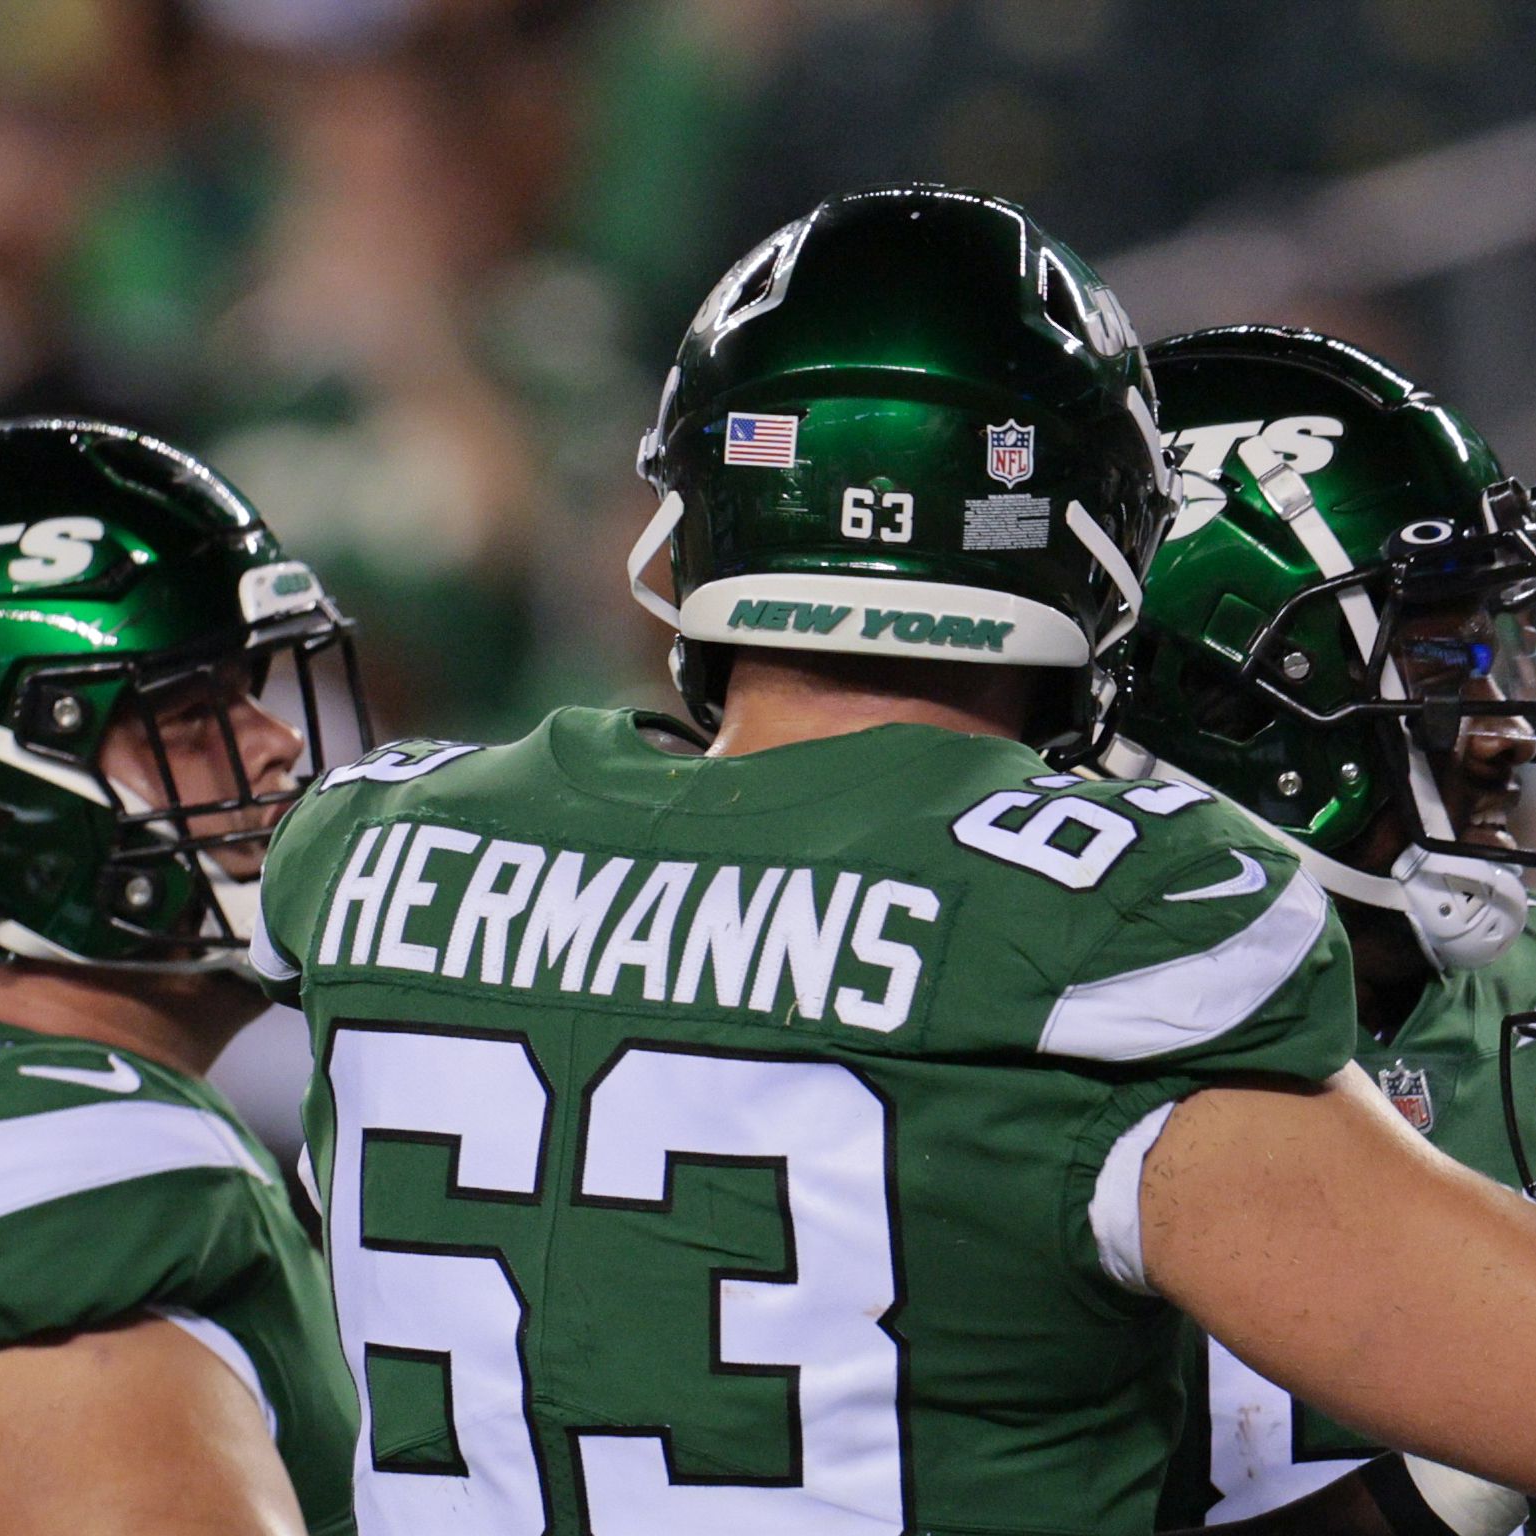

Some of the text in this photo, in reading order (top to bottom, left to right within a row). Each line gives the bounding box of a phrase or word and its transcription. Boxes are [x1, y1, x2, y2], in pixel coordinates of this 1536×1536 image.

[994, 449, 1027, 476] NFL
[841, 487, 914, 543] 63
[727, 599, 1016, 653] NEW YORK
[319, 822, 940, 1033] HERMANNS
